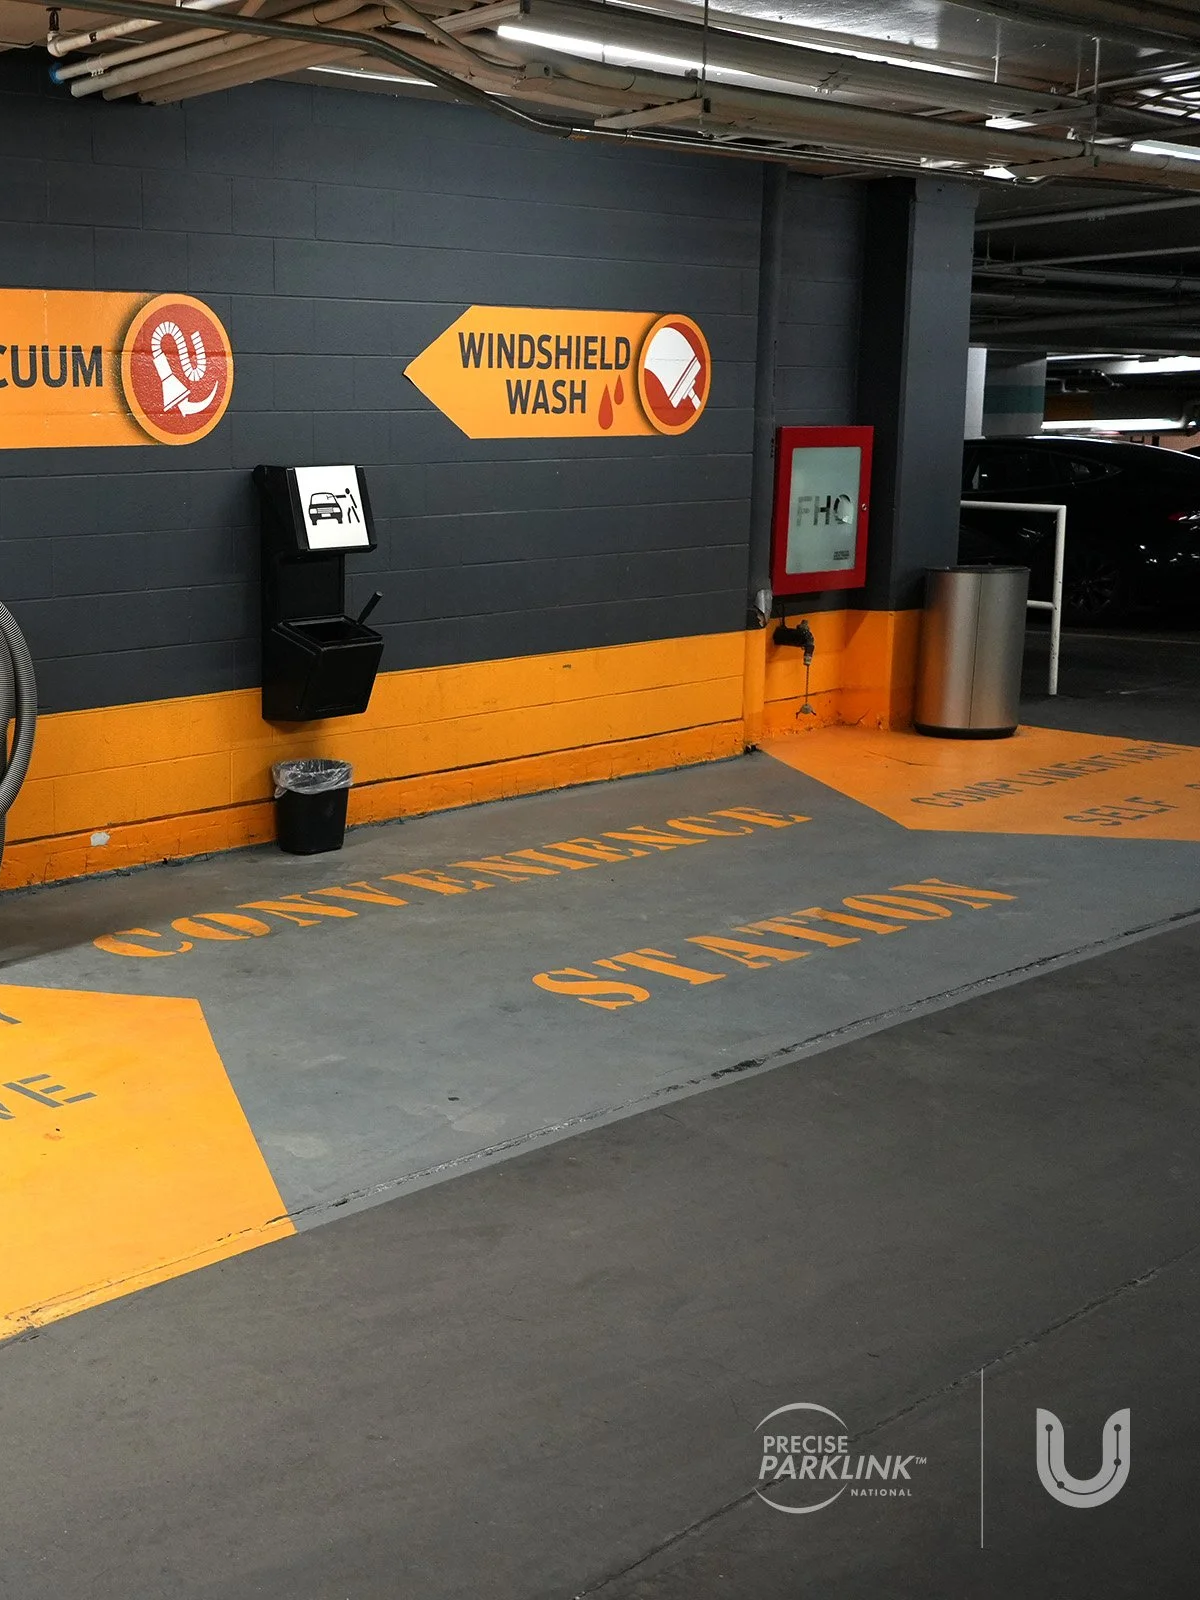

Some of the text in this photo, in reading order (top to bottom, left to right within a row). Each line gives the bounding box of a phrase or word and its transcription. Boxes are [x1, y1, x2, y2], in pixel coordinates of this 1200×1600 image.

[458, 330, 631, 371] WINDSHIELD
[505, 378, 588, 415] WASH
[796, 494, 851, 527] FHC
[1063, 796, 1179, 827] SELF
[92, 804, 813, 959] CONVENIENCE
[531, 877, 1019, 1012] STATION
